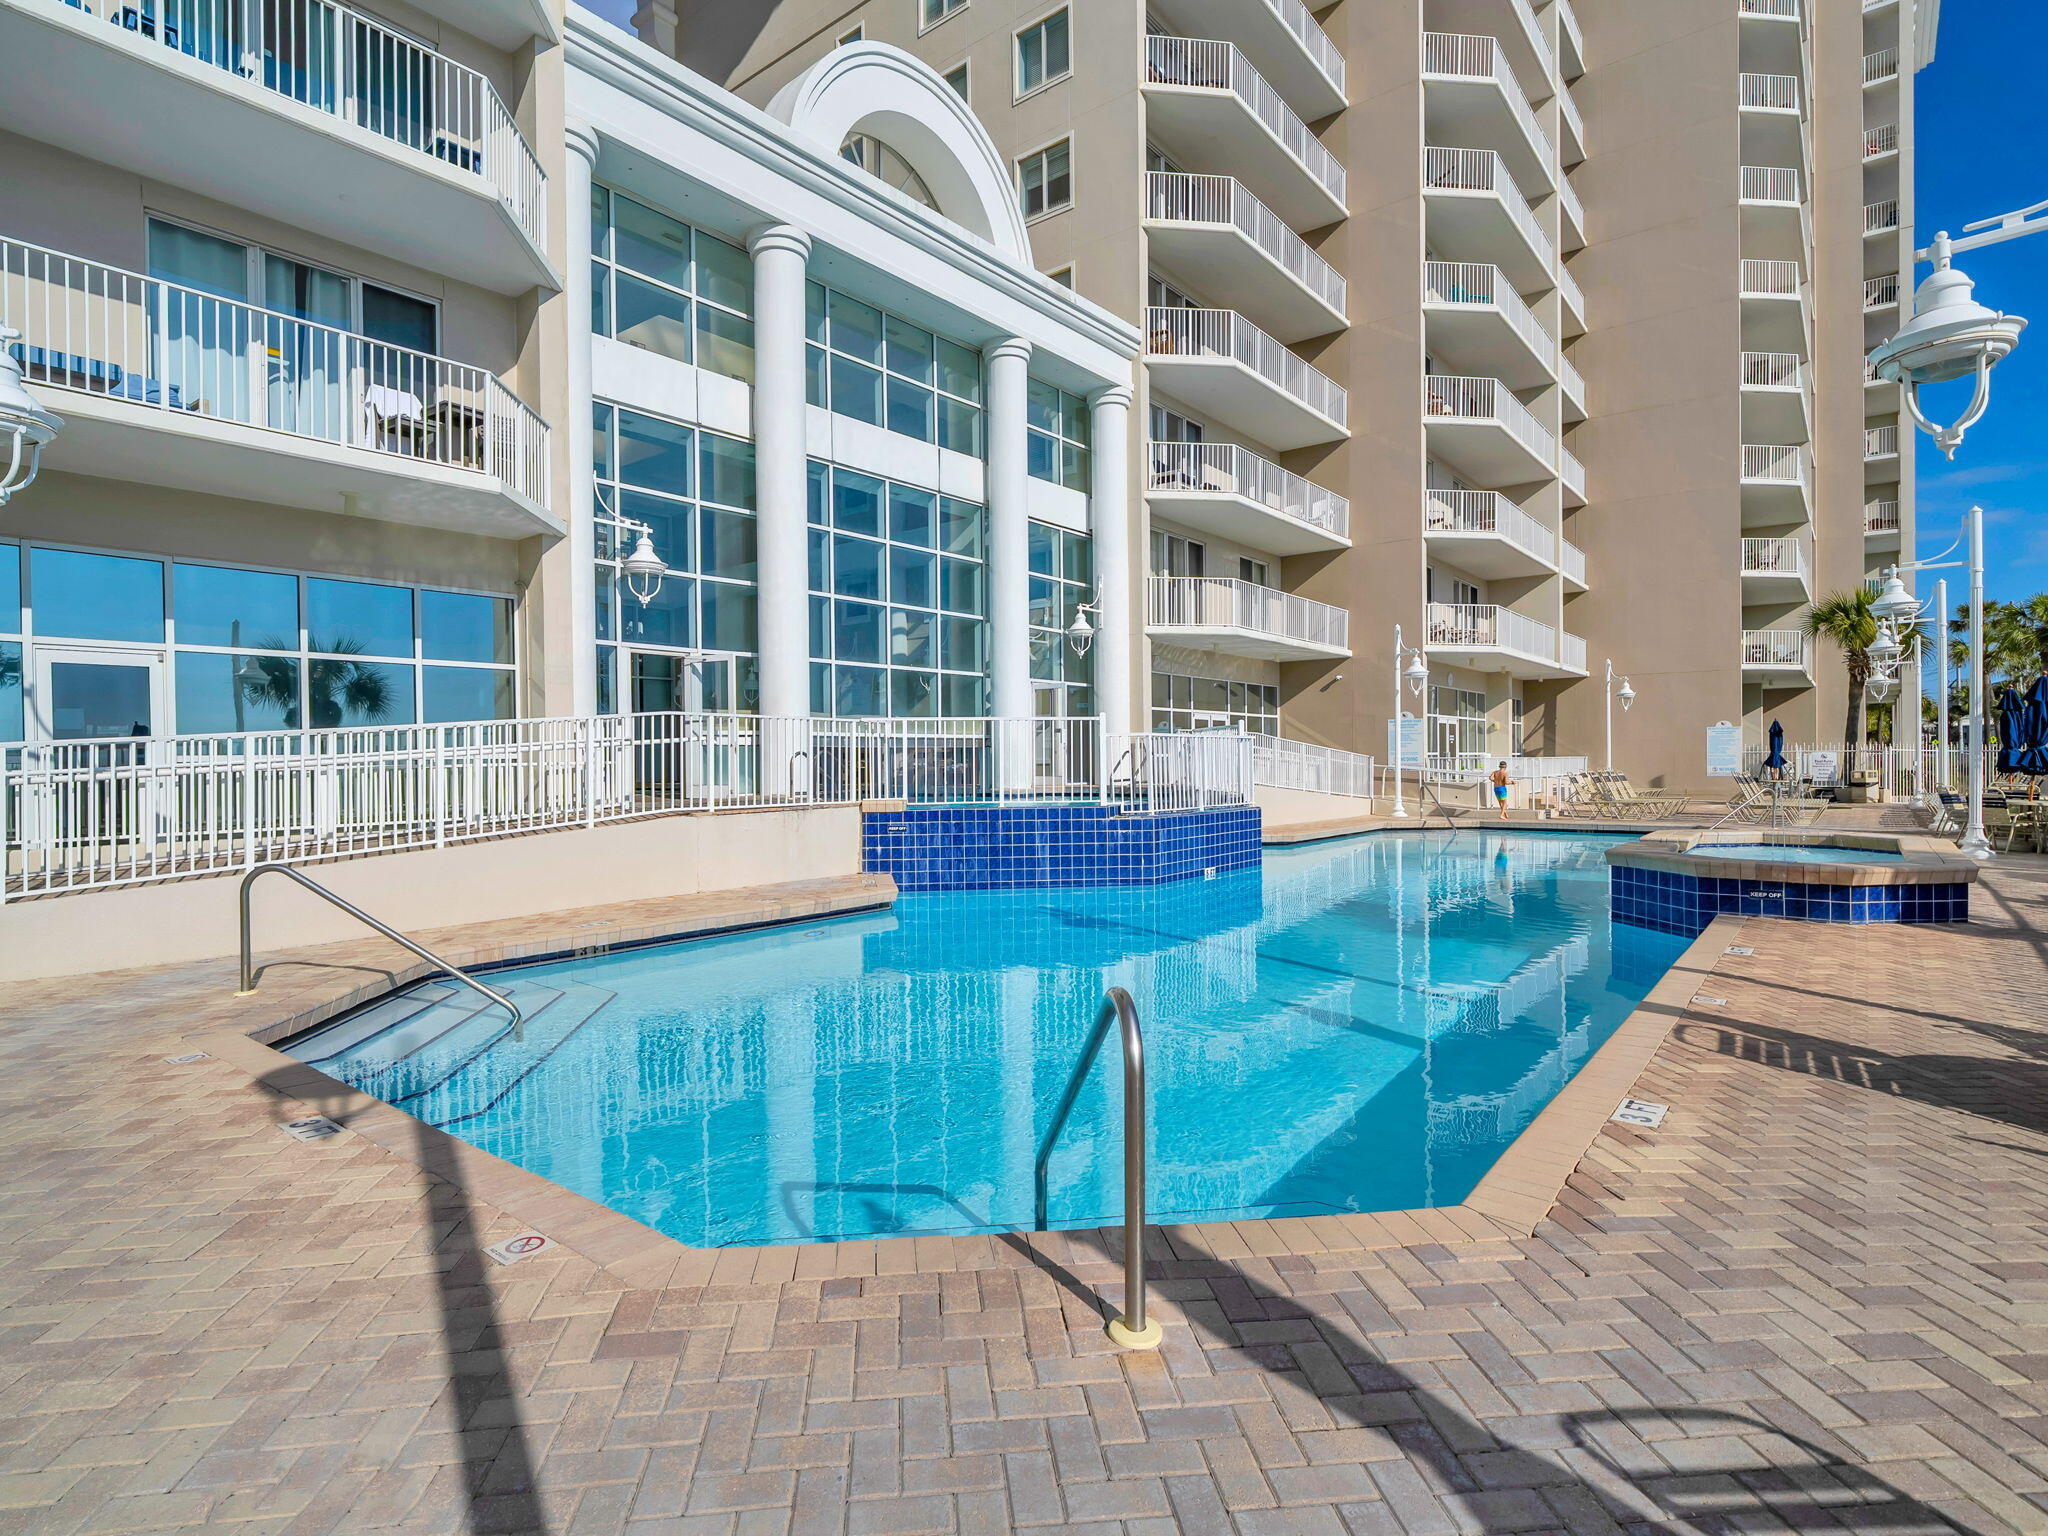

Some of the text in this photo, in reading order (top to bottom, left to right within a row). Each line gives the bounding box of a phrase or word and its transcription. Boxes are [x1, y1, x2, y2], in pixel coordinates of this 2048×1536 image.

[1619, 1100, 1661, 1123] 3 FT
[288, 1119, 341, 1139] 3 FT
